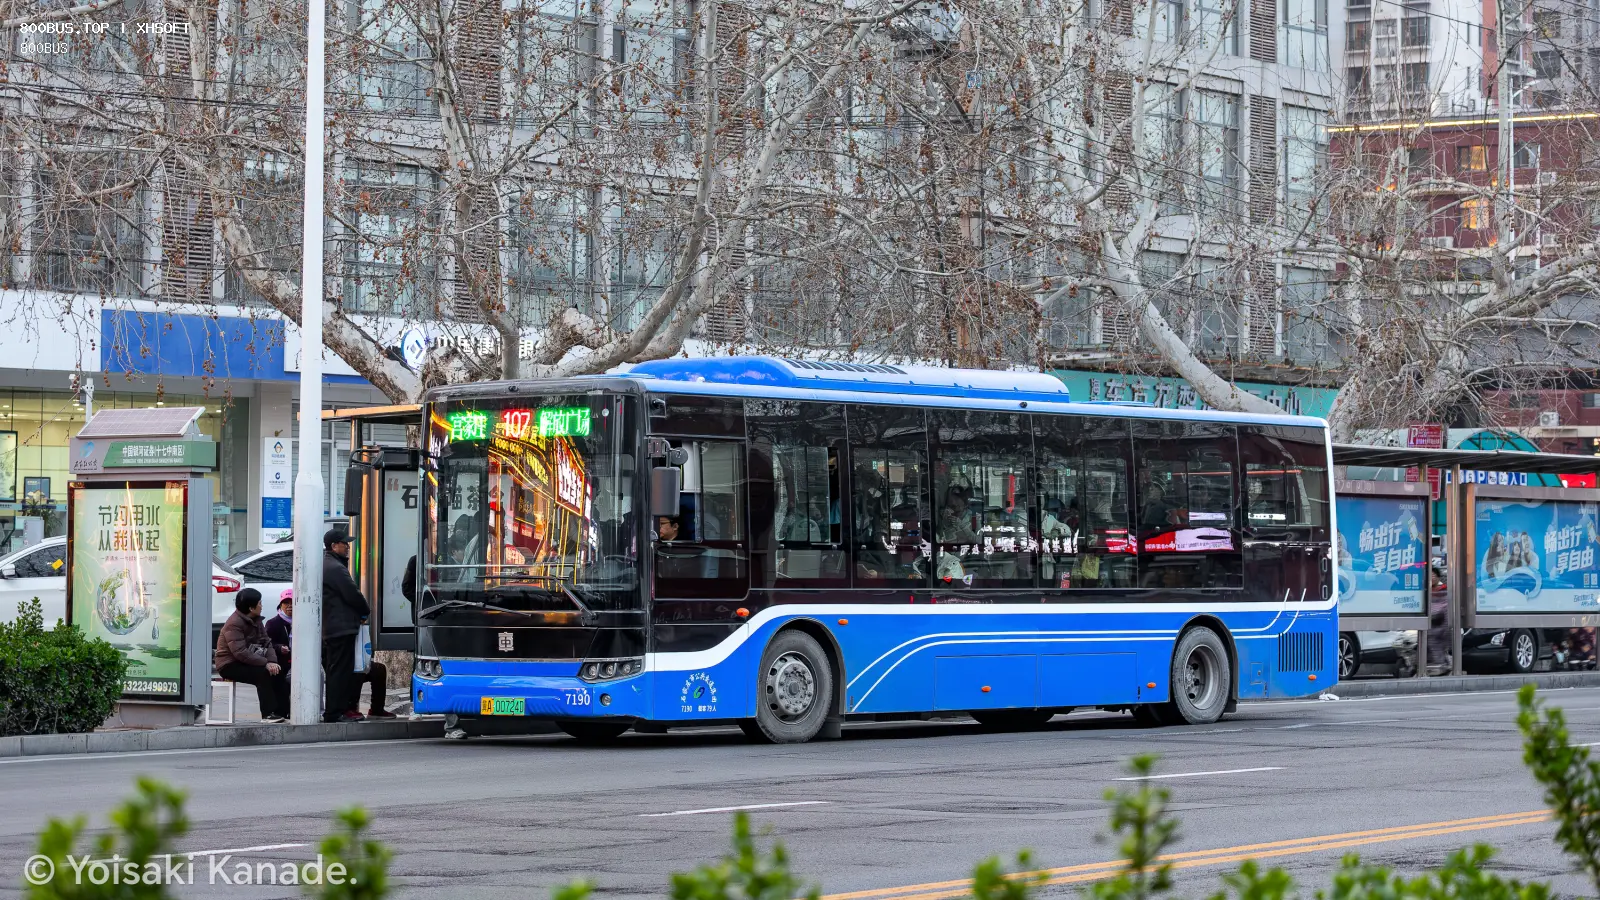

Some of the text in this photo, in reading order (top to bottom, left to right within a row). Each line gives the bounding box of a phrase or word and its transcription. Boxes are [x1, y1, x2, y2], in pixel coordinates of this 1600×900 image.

[503, 411, 530, 437] 107
[539, 408, 590, 436] 解放广场
[1510, 471, 1528, 486] 入口
[98, 504, 161, 527] 节约用水
[98, 529, 160, 551] 从我做起
[1359, 521, 1403, 553] 畅出行
[1544, 524, 1582, 555] 畅出行
[1373, 544, 1416, 574] 享自由
[1556, 545, 1594, 575] 享自由
[565, 693, 590, 706] 7190
